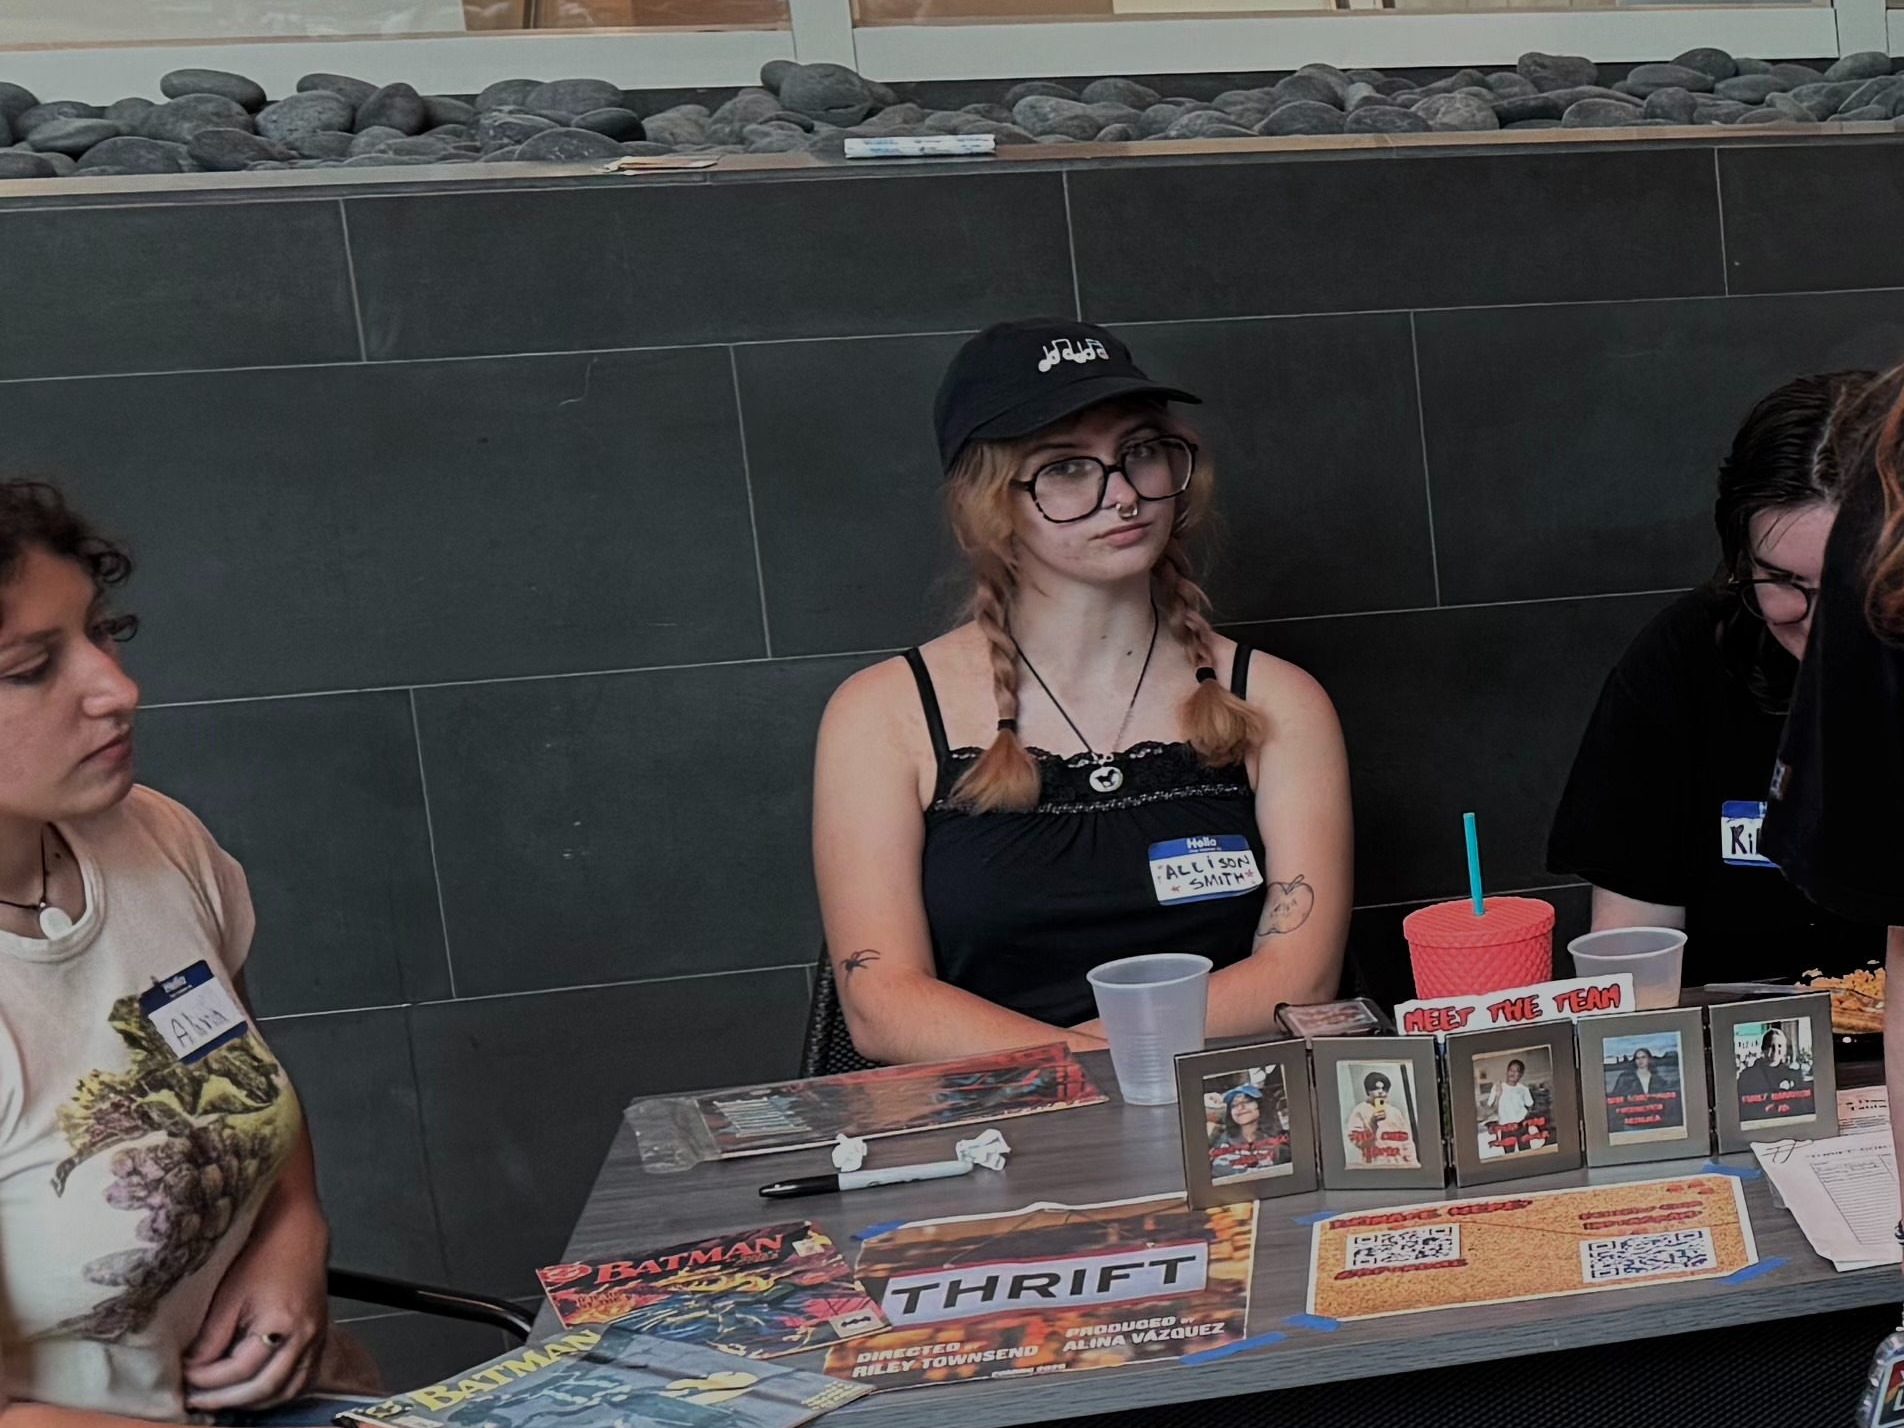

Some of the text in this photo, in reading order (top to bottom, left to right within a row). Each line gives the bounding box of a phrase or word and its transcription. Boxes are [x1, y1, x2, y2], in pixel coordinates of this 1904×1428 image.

[1186, 836, 1217, 850] Hello
[1189, 872, 1246, 891] SMITH
[1404, 982, 1622, 1034] MEET THE TEAM
[593, 1234, 784, 1285] BATMAN
[890, 1254, 1197, 1315] THRIFT
[1062, 1322, 1226, 1352] ALINA VÁZQUEZ
[1065, 1316, 1177, 1338] PRODUCED
[852, 1345, 1039, 1379] RILEY TOWNSEND
[856, 1342, 962, 1364] DIRECTED
[408, 1328, 602, 1414] BATMAN
